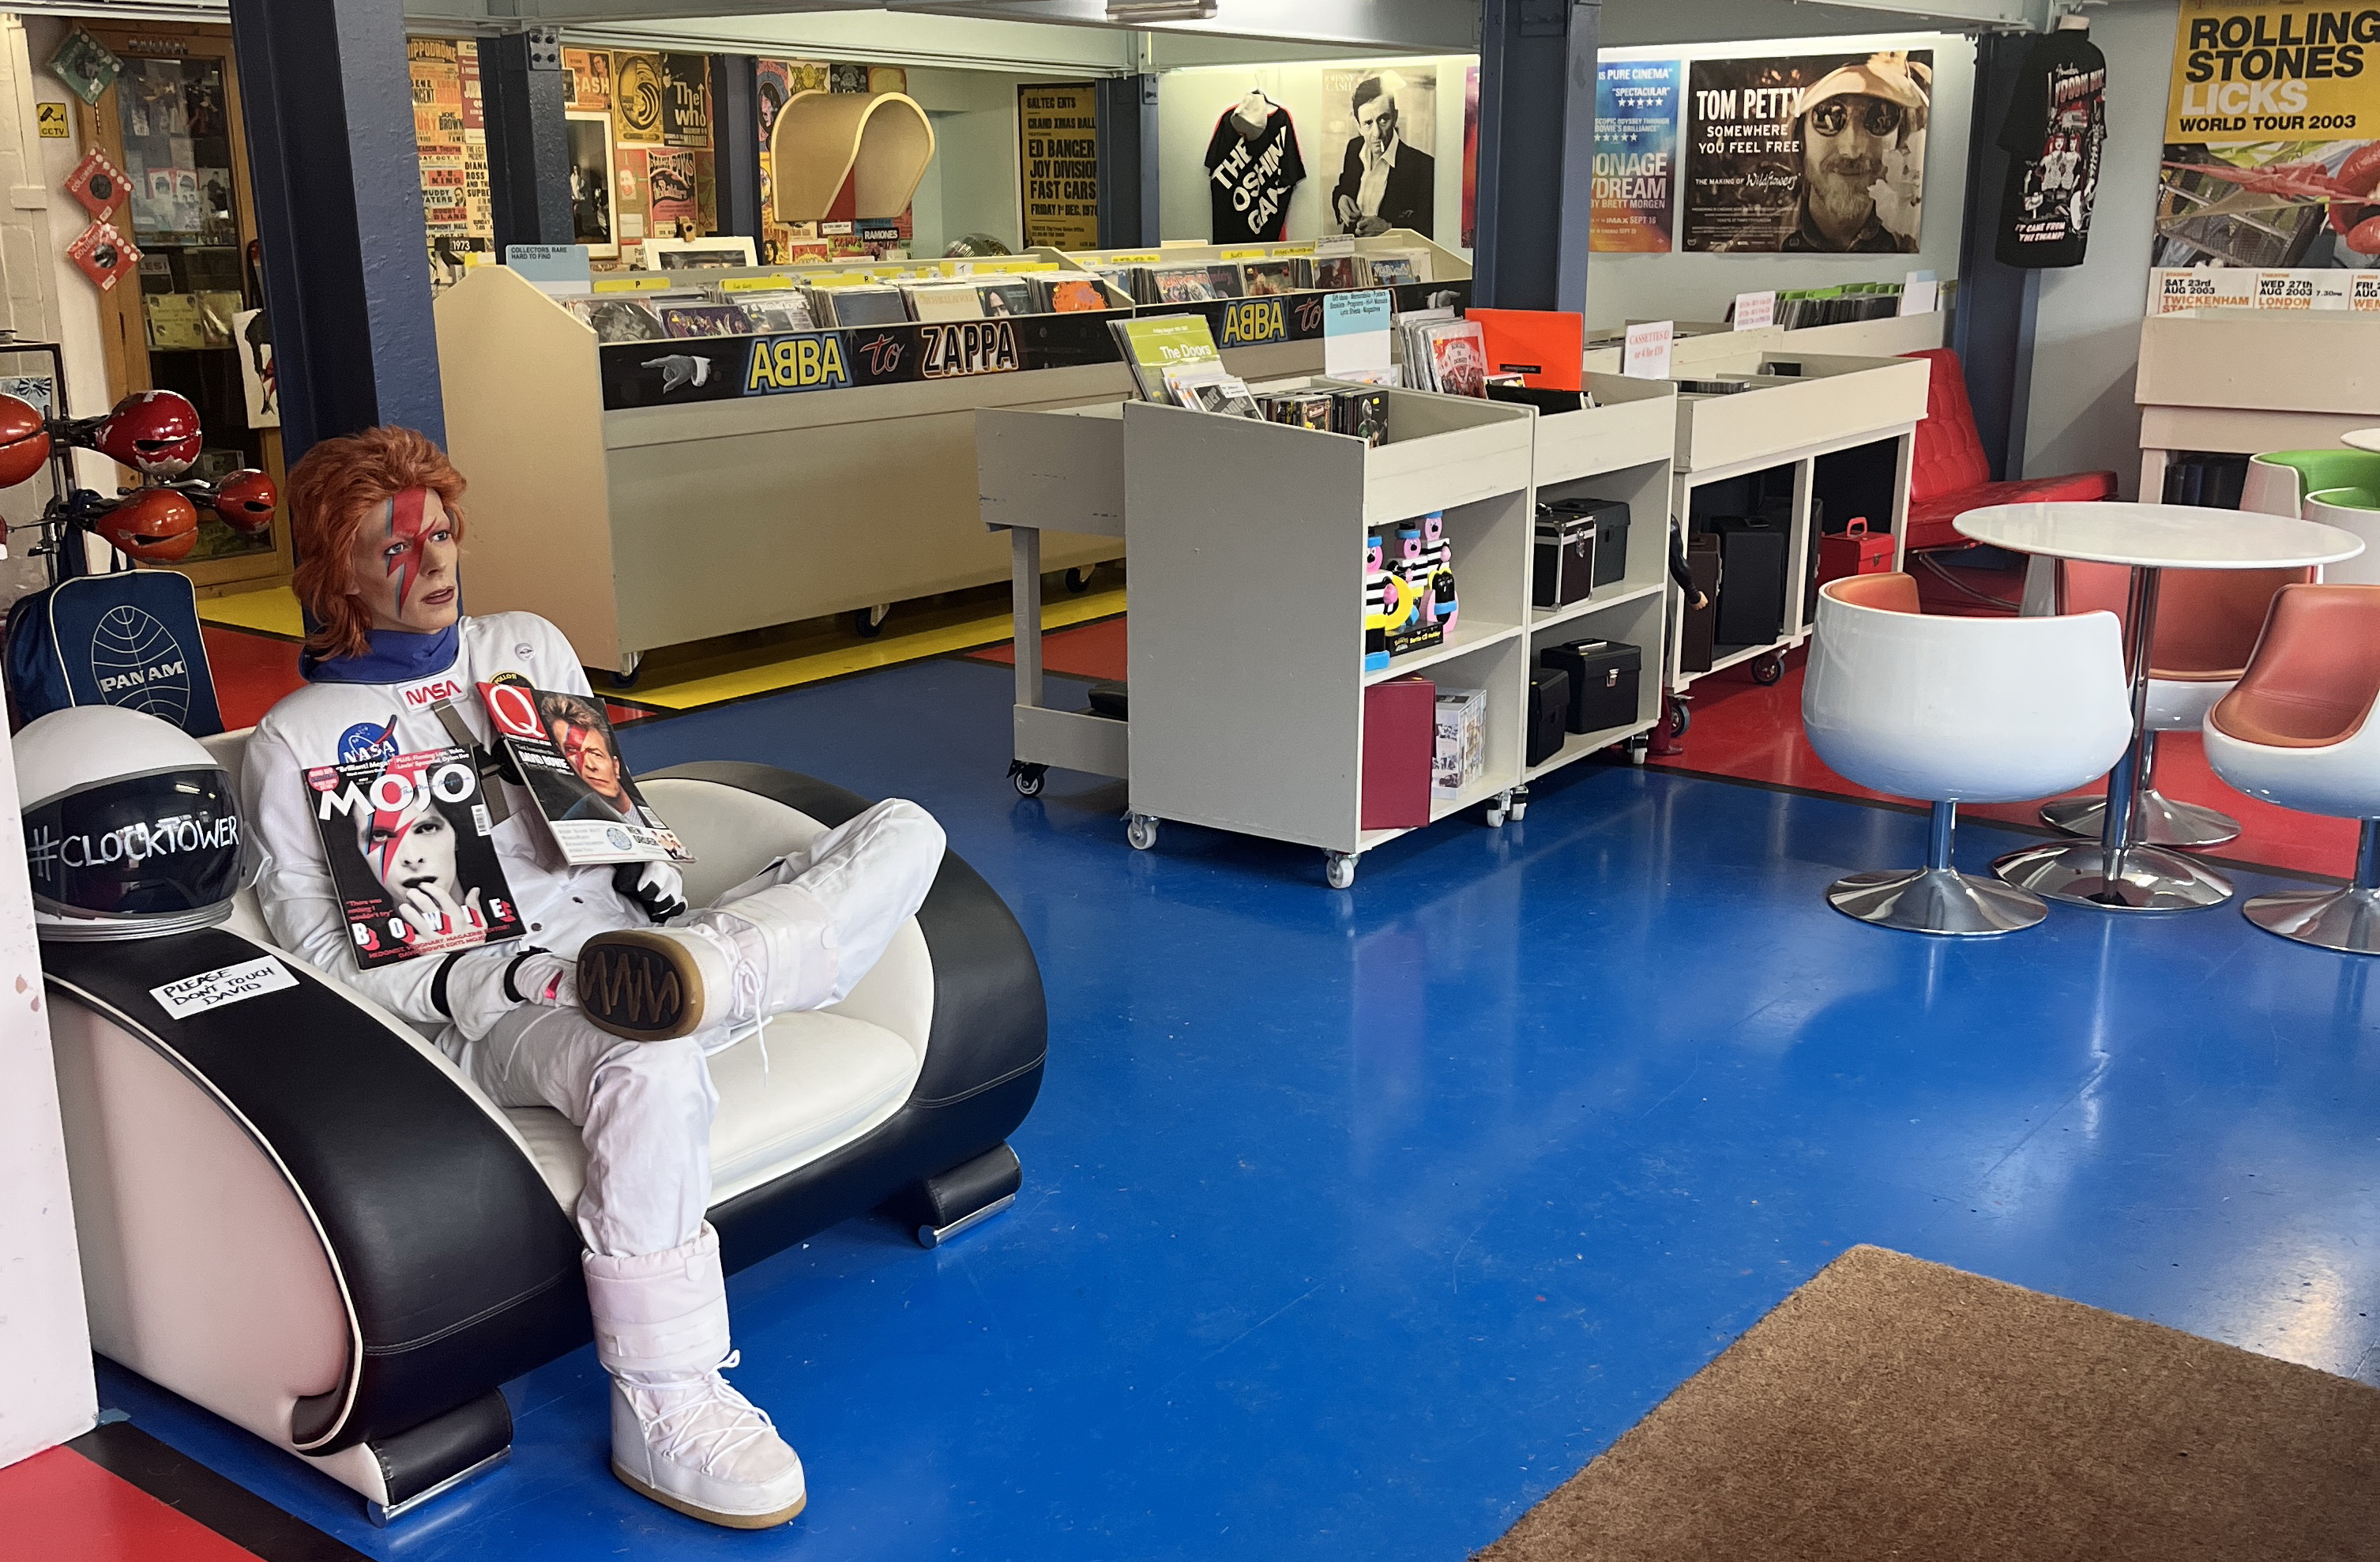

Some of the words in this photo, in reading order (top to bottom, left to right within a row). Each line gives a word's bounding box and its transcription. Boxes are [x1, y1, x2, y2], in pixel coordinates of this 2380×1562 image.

[2189, 9, 2380, 51] ROLLING
[2185, 43, 2364, 83] STONES
[1324, 74, 1353, 83] JOHNNY
[1607, 69, 1631, 81] PURE
[1632, 68, 1672, 79] CINEMA"
[1326, 81, 1352, 92] CASH
[1697, 89, 1737, 120] TOM
[1743, 87, 1806, 119] PETTY
[2181, 80, 2308, 116] LICKS
[1054, 118, 1076, 130] XMAS
[1706, 123, 1788, 137] SOMEWHERE
[2179, 119, 2247, 133] WORLD
[2252, 117, 2304, 130] TOUR
[2308, 115, 2356, 130] 2003
[1028, 139, 1043, 158] ED
[1047, 139, 1095, 158] BANGER
[1698, 142, 1724, 154] YOU
[1729, 141, 1761, 153] FEEL
[1765, 141, 1799, 152] FREE
[464, 161, 487, 170] DIANA
[1029, 160, 1051, 179] JOY
[1592, 152, 1667, 175] ONAGE
[466, 171, 485, 180] ROSS
[1030, 180, 1061, 199] FAST
[1064, 180, 1096, 199] CARS
[1031, 204, 1055, 215] FRIDAY
[1081, 204, 1097, 216] 197
[1602, 198, 1629, 209] BRETT
[1630, 199, 1666, 209] MORGEN
[1630, 216, 1647, 224] SEPT
[864, 231, 898, 240] RAMONES
[453, 240, 471, 250] 1973
[959, 264, 966, 274] T
[2164, 295, 2250, 305] TWICKENHAM
[2286, 288, 2313, 296] 2003
[2354, 289, 2378, 298] AUG
[2258, 297, 2311, 306] LONDON
[1224, 300, 1285, 344] ABBA
[1294, 297, 1323, 332] to
[1630, 332, 1664, 344] CASSETTES
[747, 334, 848, 393] ABBA
[859, 333, 905, 376] to
[921, 321, 1019, 378] ZAPPA
[1160, 346, 1181, 360] The
[1180, 344, 1213, 358] Doors
[100, 669, 145, 693] PAN
[148, 661, 185, 682] AM
[405, 679, 462, 706] NASA
[490, 684, 546, 738] Q
[343, 740, 395, 764] NASA
[518, 751, 544, 764] DAVID
[318, 764, 476, 821] MOJO
[27, 815, 239, 882] #CLOCKTOWER
[351, 898, 517, 952] BOWIE
[446, 931, 484, 943] MAGAZINE
[163, 969, 232, 999] PLEASE
[171, 984, 216, 1006] DON'T
[227, 966, 275, 986] TOUCH
[201, 983, 261, 1005] DAVID
